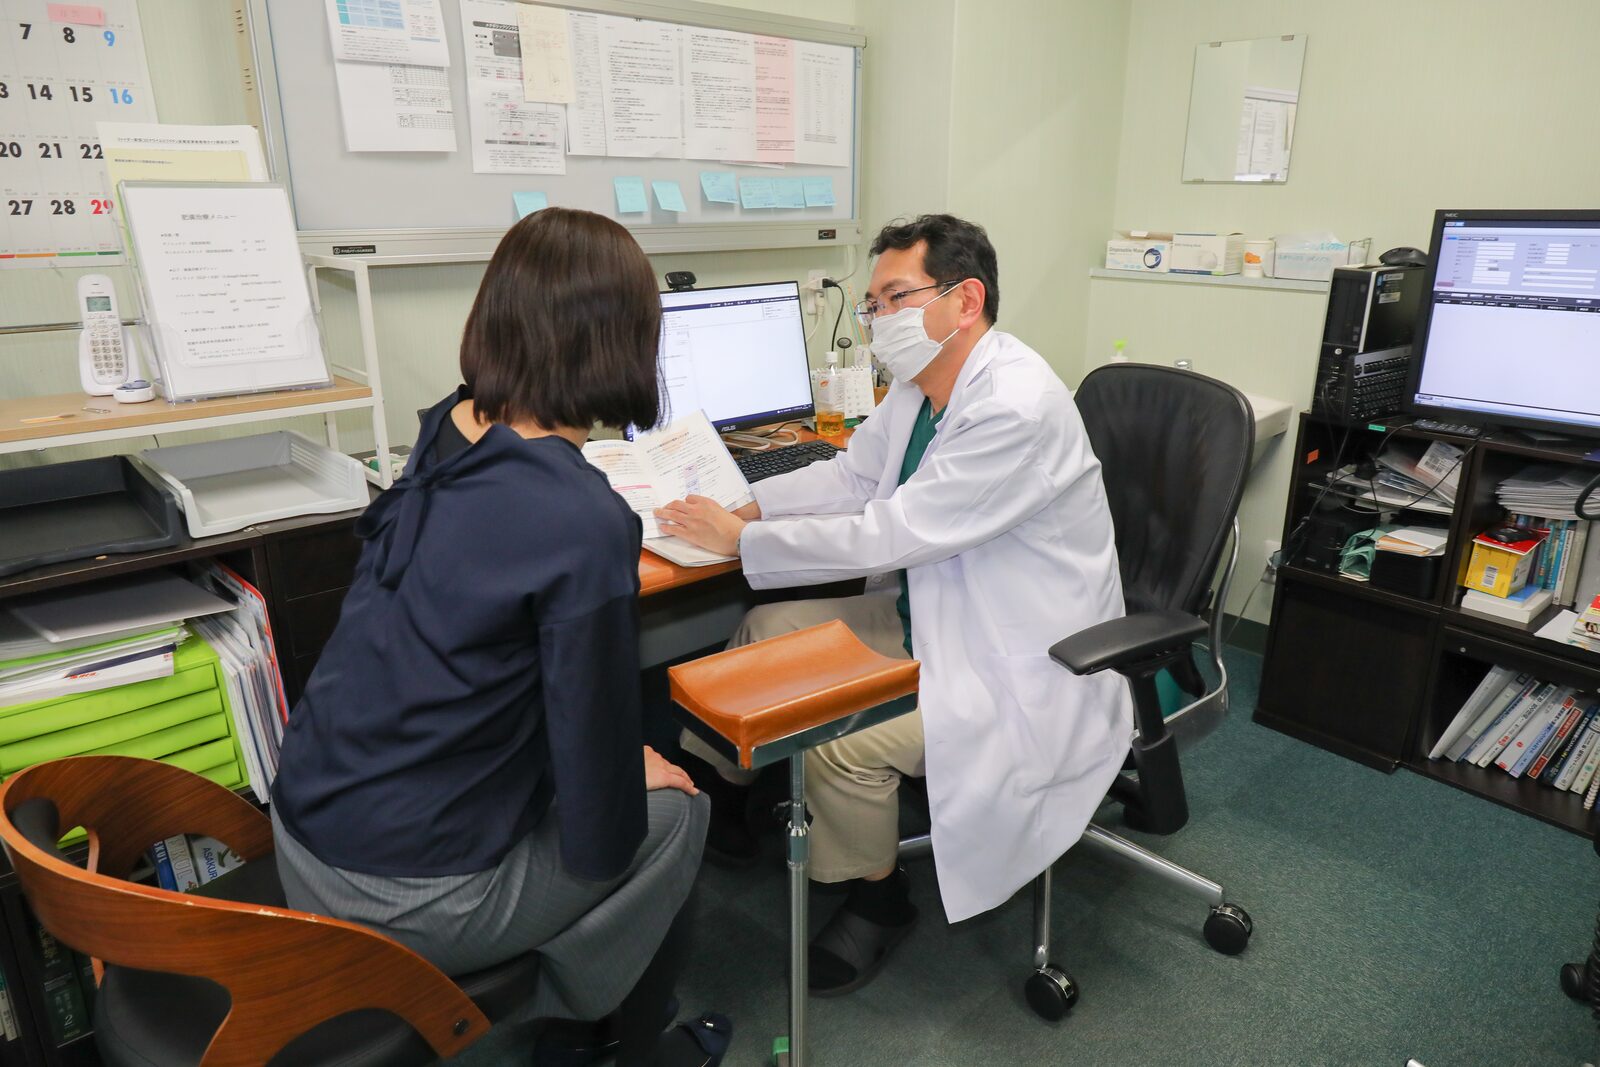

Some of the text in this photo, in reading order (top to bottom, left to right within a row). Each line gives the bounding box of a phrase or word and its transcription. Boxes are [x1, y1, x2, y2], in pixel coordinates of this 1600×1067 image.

[19, 23, 115, 47] 7 8 9
[27, 84, 53, 101] 14
[69, 86, 93, 103] 15
[110, 88, 133, 104] 16
[0, 142, 104, 159] 20 21 22
[8, 199, 114, 216] 27 28 29
[64, 1014, 73, 1026] 2
